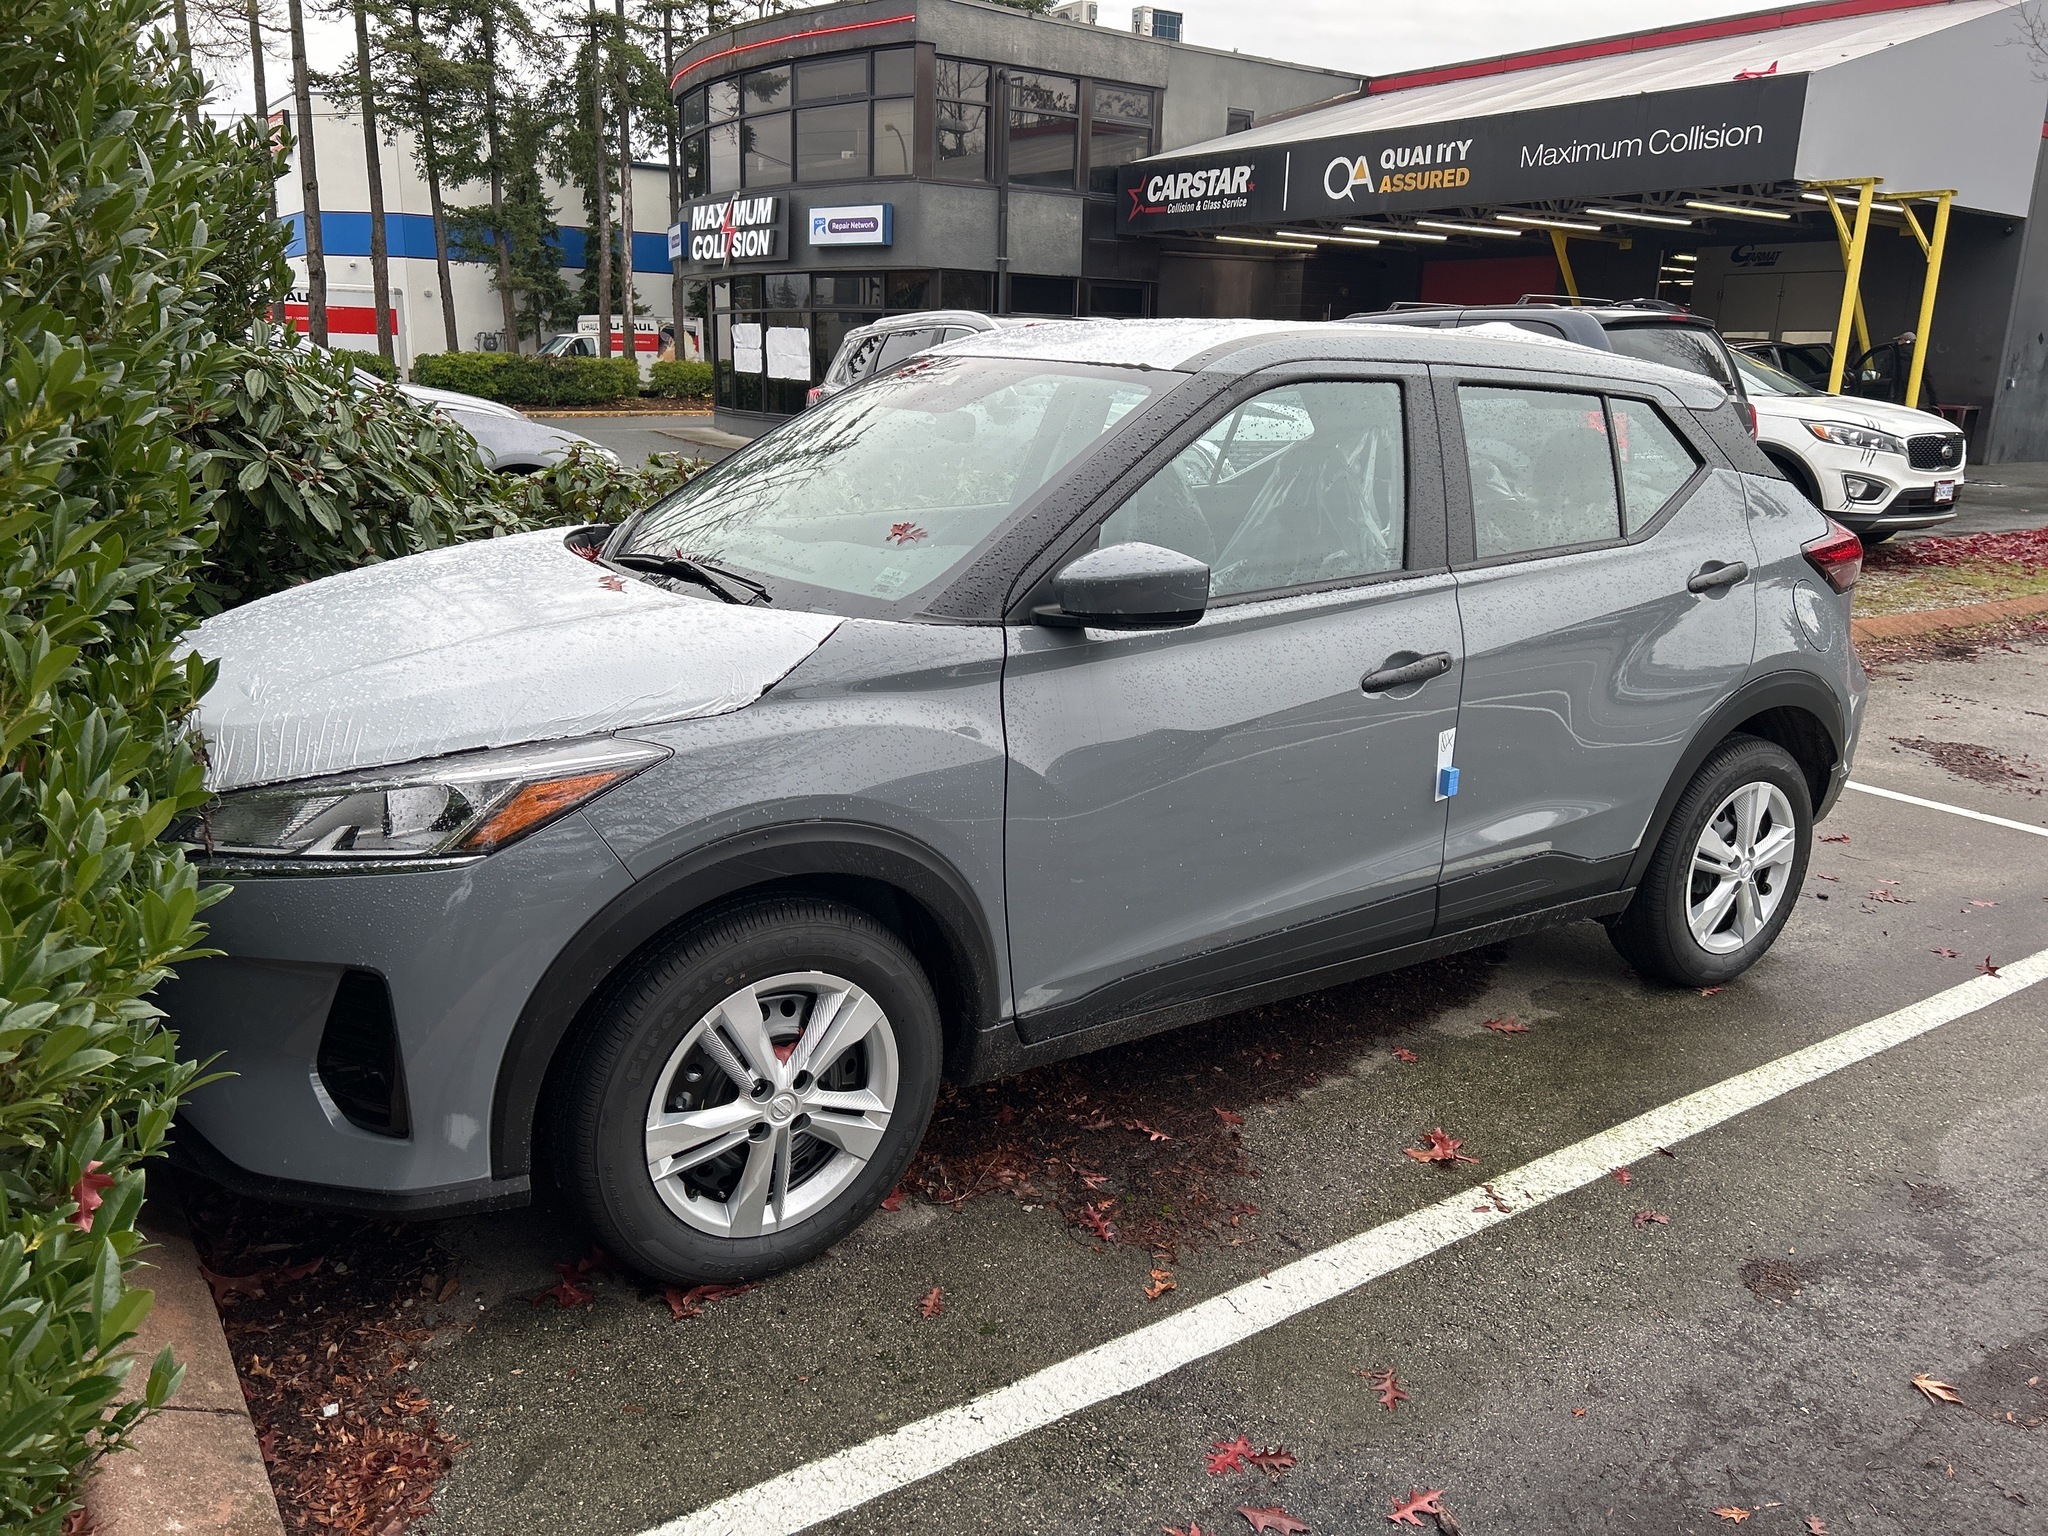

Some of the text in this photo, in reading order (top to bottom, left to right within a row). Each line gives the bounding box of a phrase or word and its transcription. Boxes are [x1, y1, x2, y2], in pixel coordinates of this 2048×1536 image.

[1380, 139, 1473, 169] QUALITY
[1519, 121, 1763, 168] Maximum Collision
[1147, 165, 1251, 203] CARSTAR
[1323, 154, 1374, 203] QA
[1378, 167, 1470, 194] ASSURED
[1167, 197, 1248, 214] Collision & Glass Service
[831, 220, 875, 231] Repair Network
[610, 322, 654, 331] U-AUL
